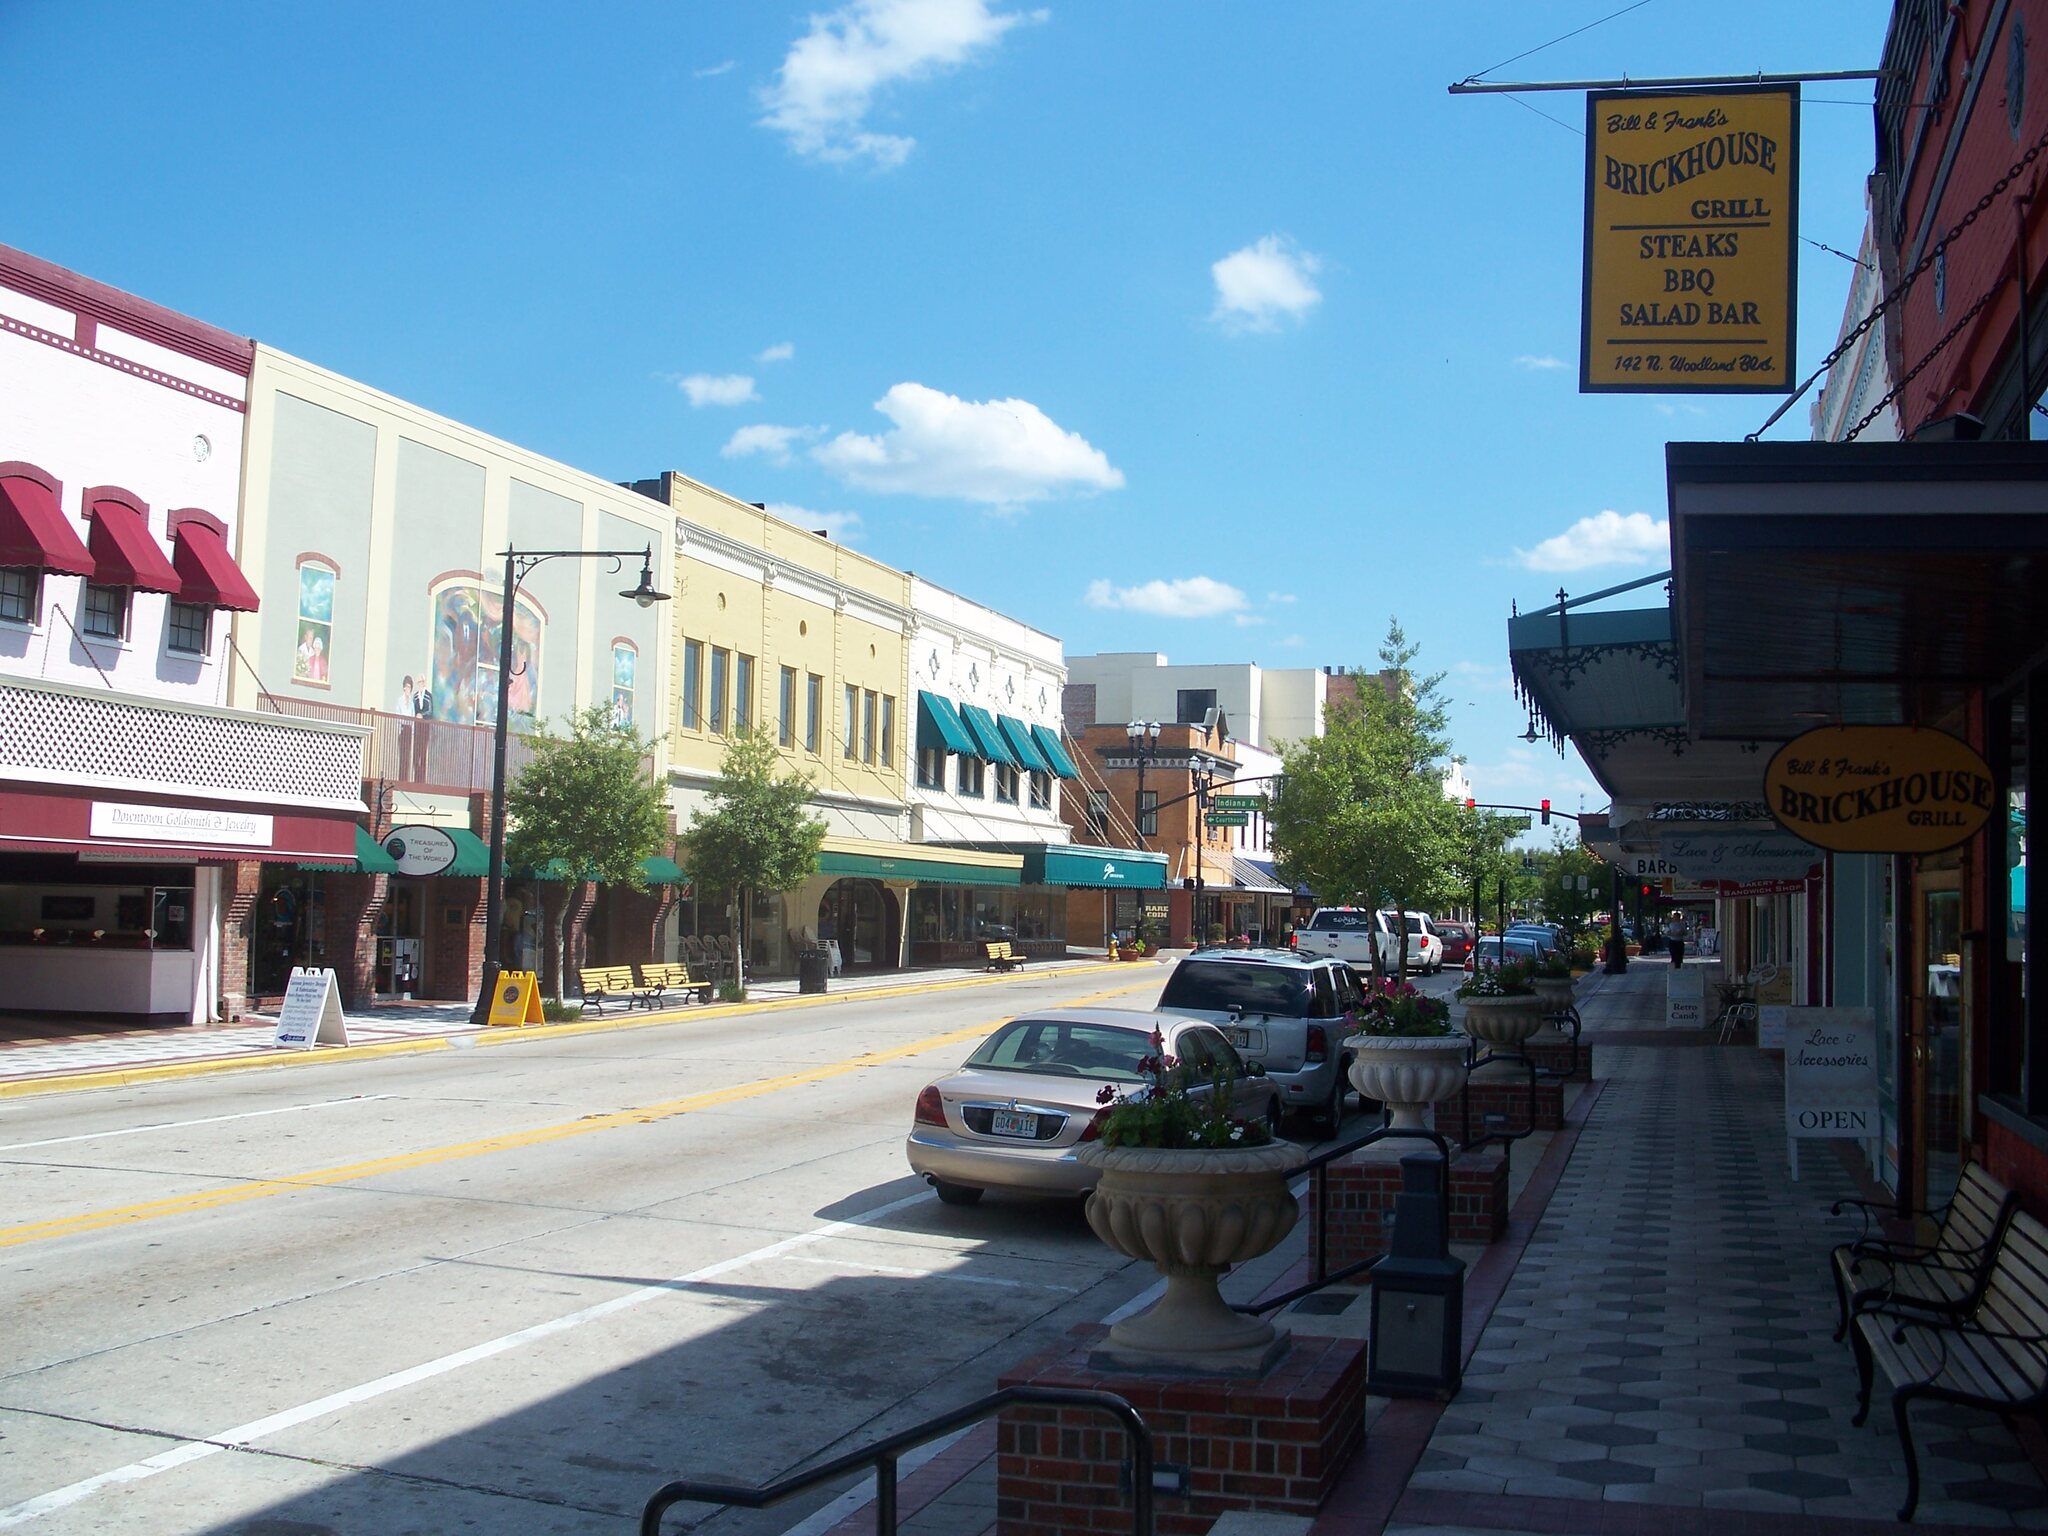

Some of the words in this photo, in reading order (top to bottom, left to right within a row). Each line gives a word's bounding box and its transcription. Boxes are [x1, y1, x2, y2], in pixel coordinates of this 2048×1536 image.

[1606, 112, 1641, 133] Bill
[1645, 110, 1658, 129] &
[1663, 107, 1729, 133] Frank's
[1604, 132, 1777, 195] BRICKHOUSE
[1691, 198, 1771, 219] GRILL
[1639, 233, 1739, 259] STEAKS
[1663, 268, 1715, 296] BBQ
[1620, 302, 1701, 326] SALAD
[1706, 302, 1761, 325] BAR
[1669, 355, 1737, 372] Woodland
[1786, 758, 1816, 775] Bill
[1818, 758, 1830, 775] &
[1835, 757, 1891, 778] Frank's
[1217, 799, 1246, 807] Indiana
[1779, 770, 1993, 824] BRICKHOUSE
[112, 808, 164, 825] Downtown
[166, 811, 211, 829] Goldsmith
[224, 815, 257, 836] Jewelry
[1906, 810, 1968, 826] GRILL
[410, 838, 449, 848] TREASURES
[1671, 839, 1708, 858] Lace
[1733, 839, 1818, 857] Accessories
[423, 855, 449, 863] WORLD
[1723, 886, 1773, 896] SANDWICH
[1775, 884, 1803, 892] SHOP
[1671, 1012, 1699, 1022] Candy
[1673, 1003, 1699, 1011] Retro
[1804, 1028, 1841, 1047] Lace
[1788, 1049, 1872, 1070] Accessories
[1799, 1110, 1867, 1130] OPEN
